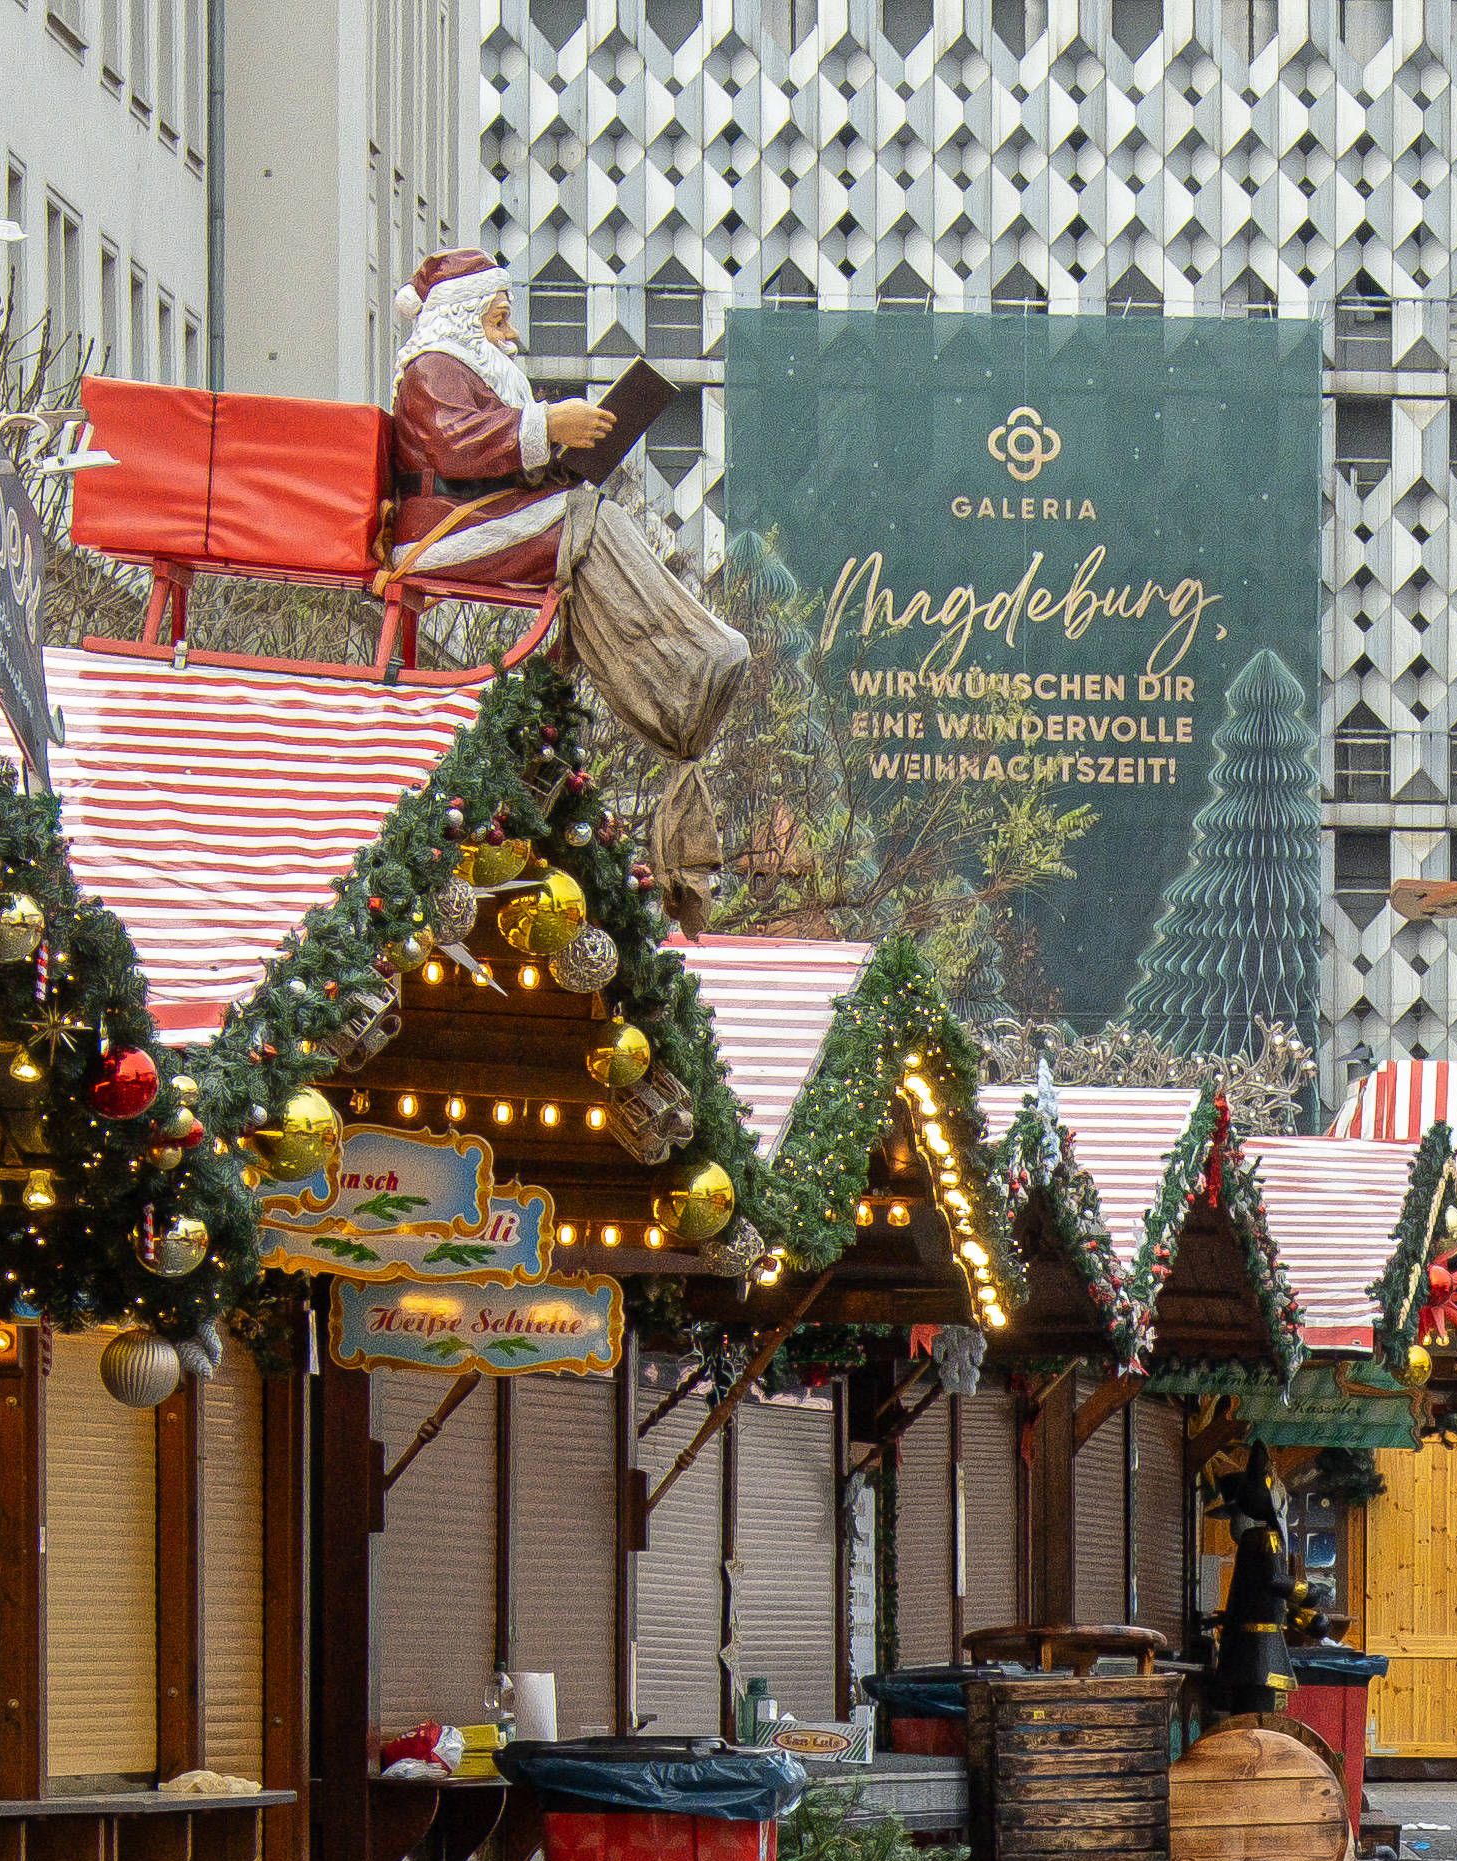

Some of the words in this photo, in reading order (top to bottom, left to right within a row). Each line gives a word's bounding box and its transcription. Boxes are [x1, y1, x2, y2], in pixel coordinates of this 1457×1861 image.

[951, 496, 1097, 520] GALERIA
[820, 545, 1230, 677] Magdeburg,
[850, 670, 931, 699] WIR
[932, 664, 1127, 701] WÜNSCHEN
[1138, 672, 1195, 701] DIR
[851, 711, 925, 740] EINE
[935, 713, 1194, 743] WUNDERVOLLE
[869, 753, 1178, 784] WEIHNACHTSZEIT!
